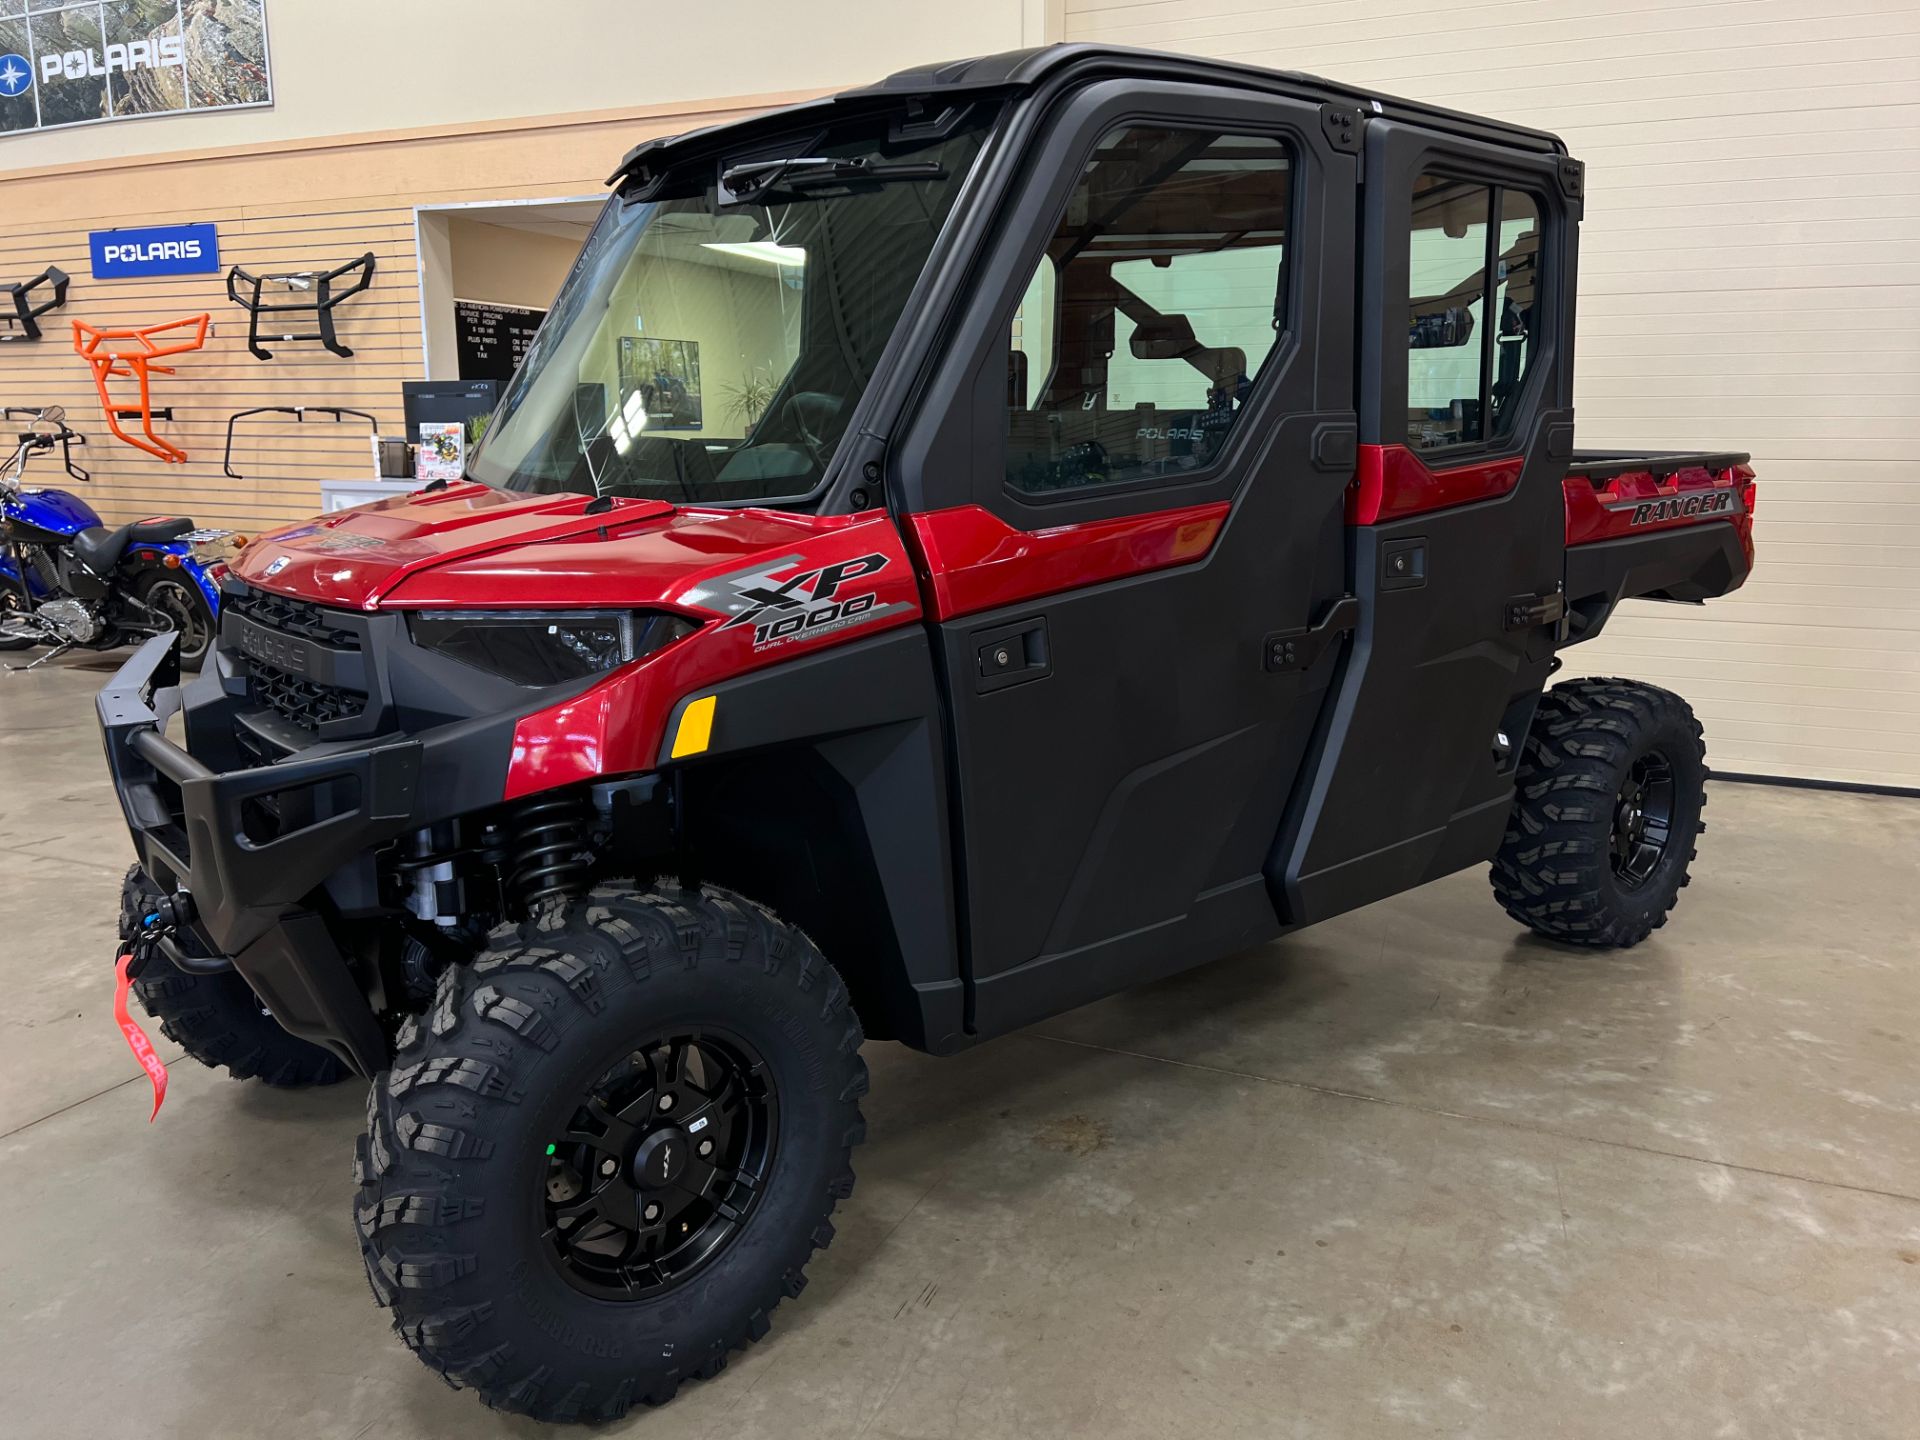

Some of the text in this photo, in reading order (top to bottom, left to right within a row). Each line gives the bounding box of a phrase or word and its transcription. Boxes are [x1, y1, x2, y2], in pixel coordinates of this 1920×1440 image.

[40, 35, 183, 84] POLARIS
[104, 239, 202, 263] POLARIS
[460, 309, 503, 320] SERVICE PRICING
[1136, 428, 1205, 440] POLARIS
[1630, 491, 1730, 525] RANGER
[709, 552, 891, 635] XP
[752, 592, 877, 647] 1000
[754, 612, 871, 654] DUAL OVERHEAD CAM
[123, 1022, 167, 1094] POLARIS
